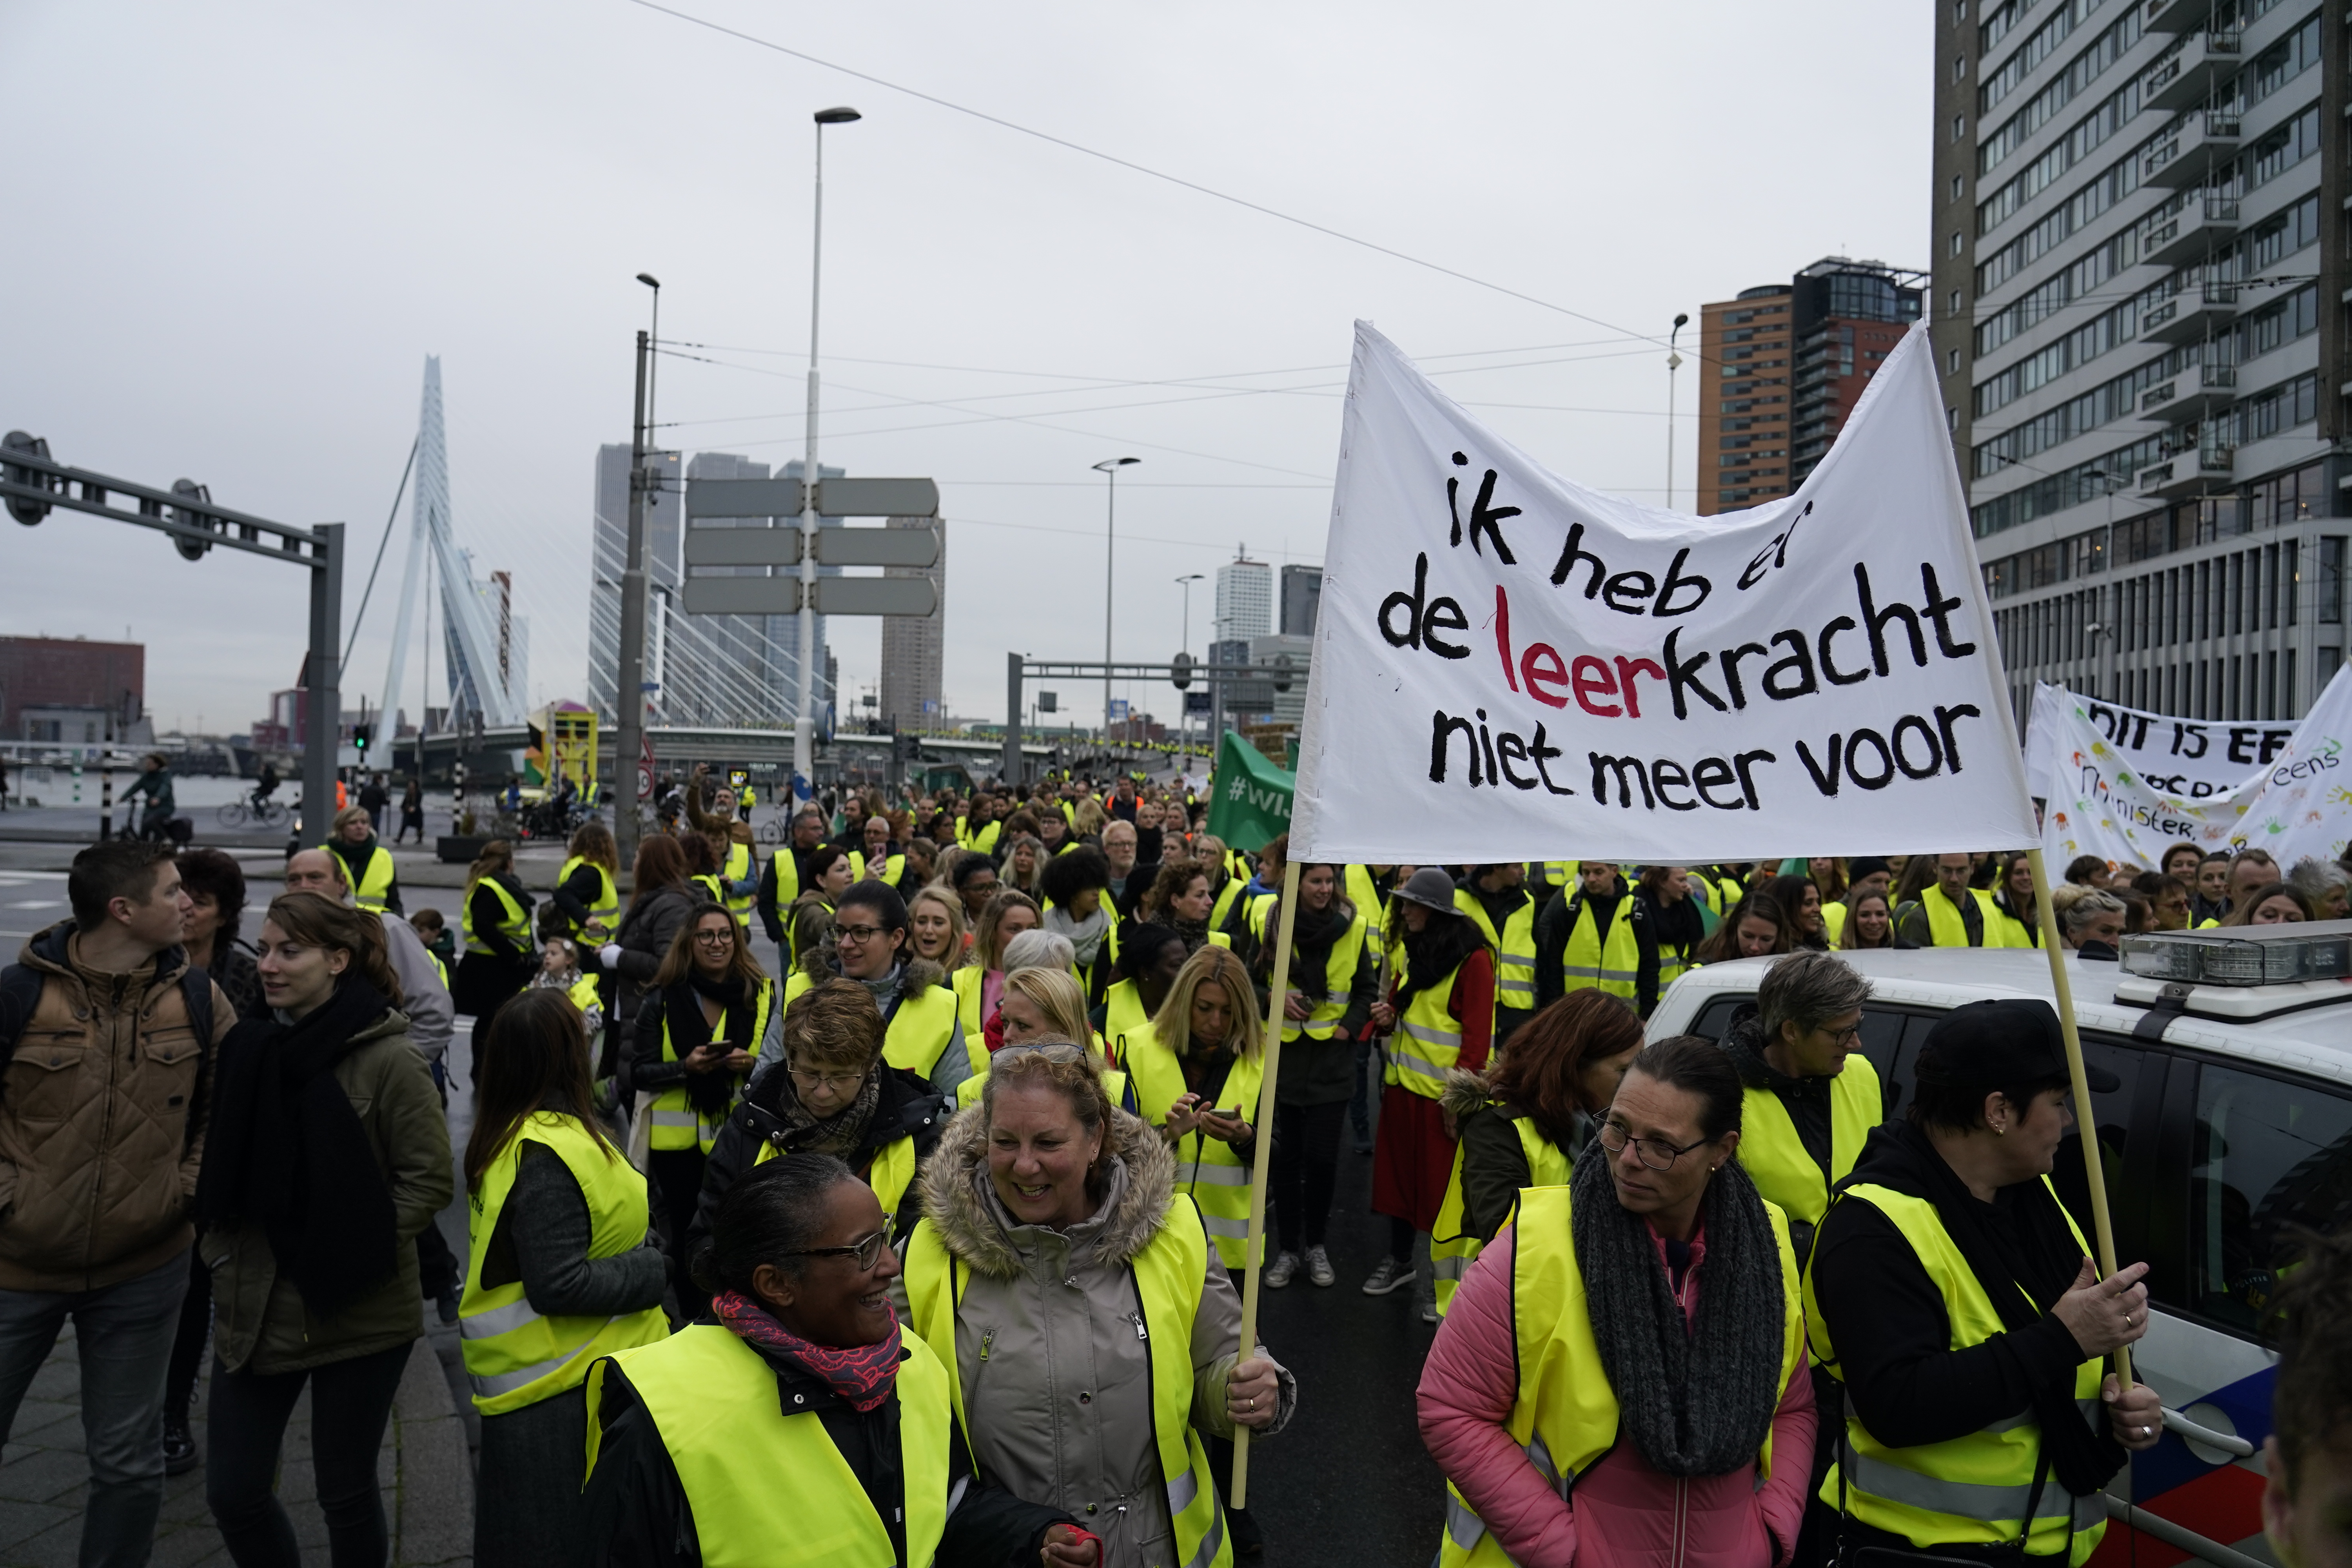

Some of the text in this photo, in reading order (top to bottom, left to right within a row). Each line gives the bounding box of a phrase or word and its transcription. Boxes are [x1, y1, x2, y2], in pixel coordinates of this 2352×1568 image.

[1446, 451, 1813, 617] ik heb er
[1377, 551, 1976, 721] de leerkracht
[1429, 704, 1981, 811] niet meer voor
[2089, 703, 2292, 765] DIT IS EE
[2235, 1276, 2268, 1288] POLITIE
